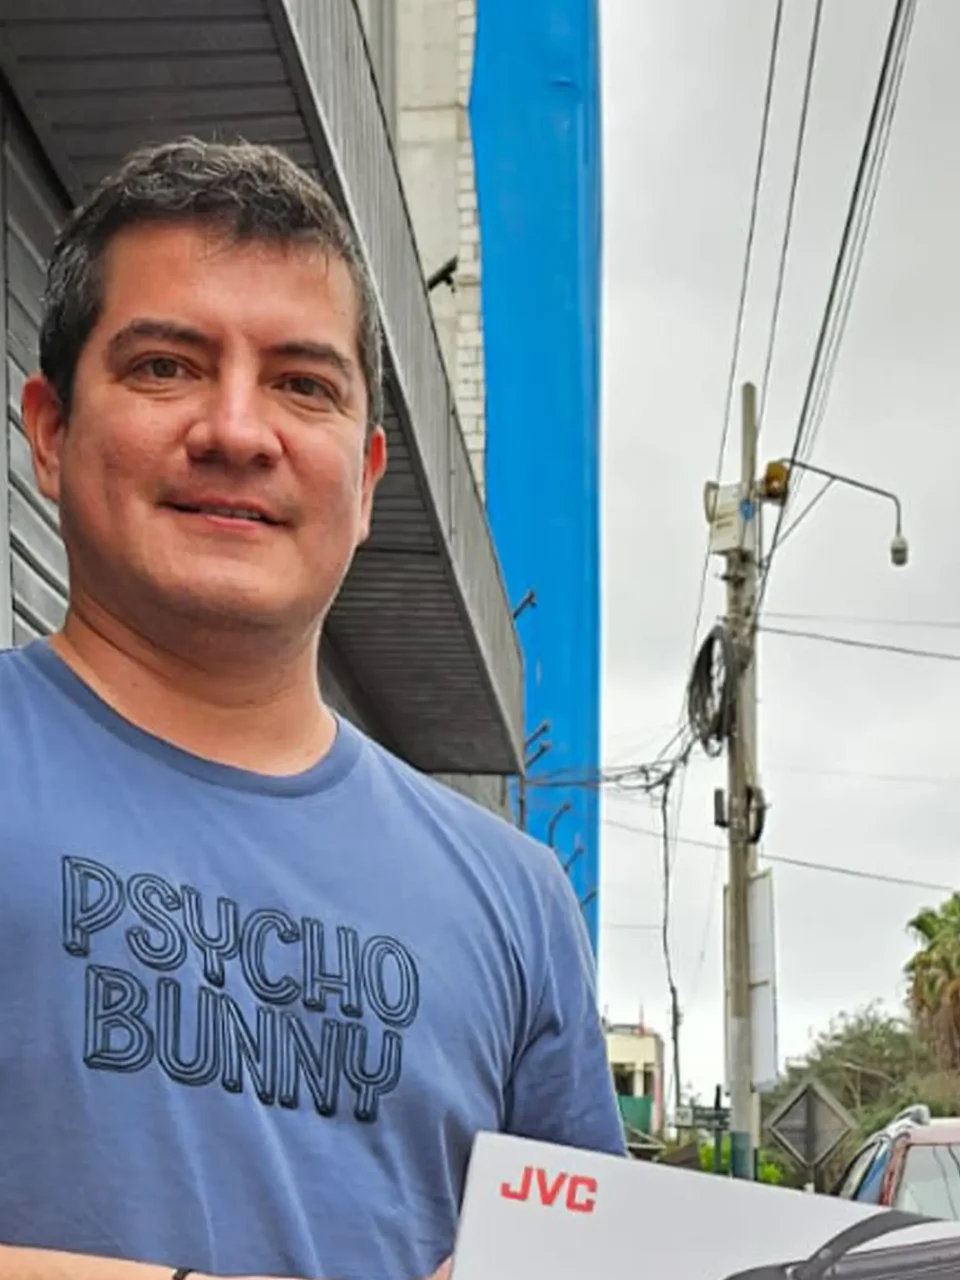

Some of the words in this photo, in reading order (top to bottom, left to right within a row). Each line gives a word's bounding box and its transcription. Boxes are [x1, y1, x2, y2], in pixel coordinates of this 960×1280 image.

[62, 855, 420, 1027] PSYCHO
[83, 963, 402, 1124] BUNNY
[500, 1165, 598, 1213] JVC
